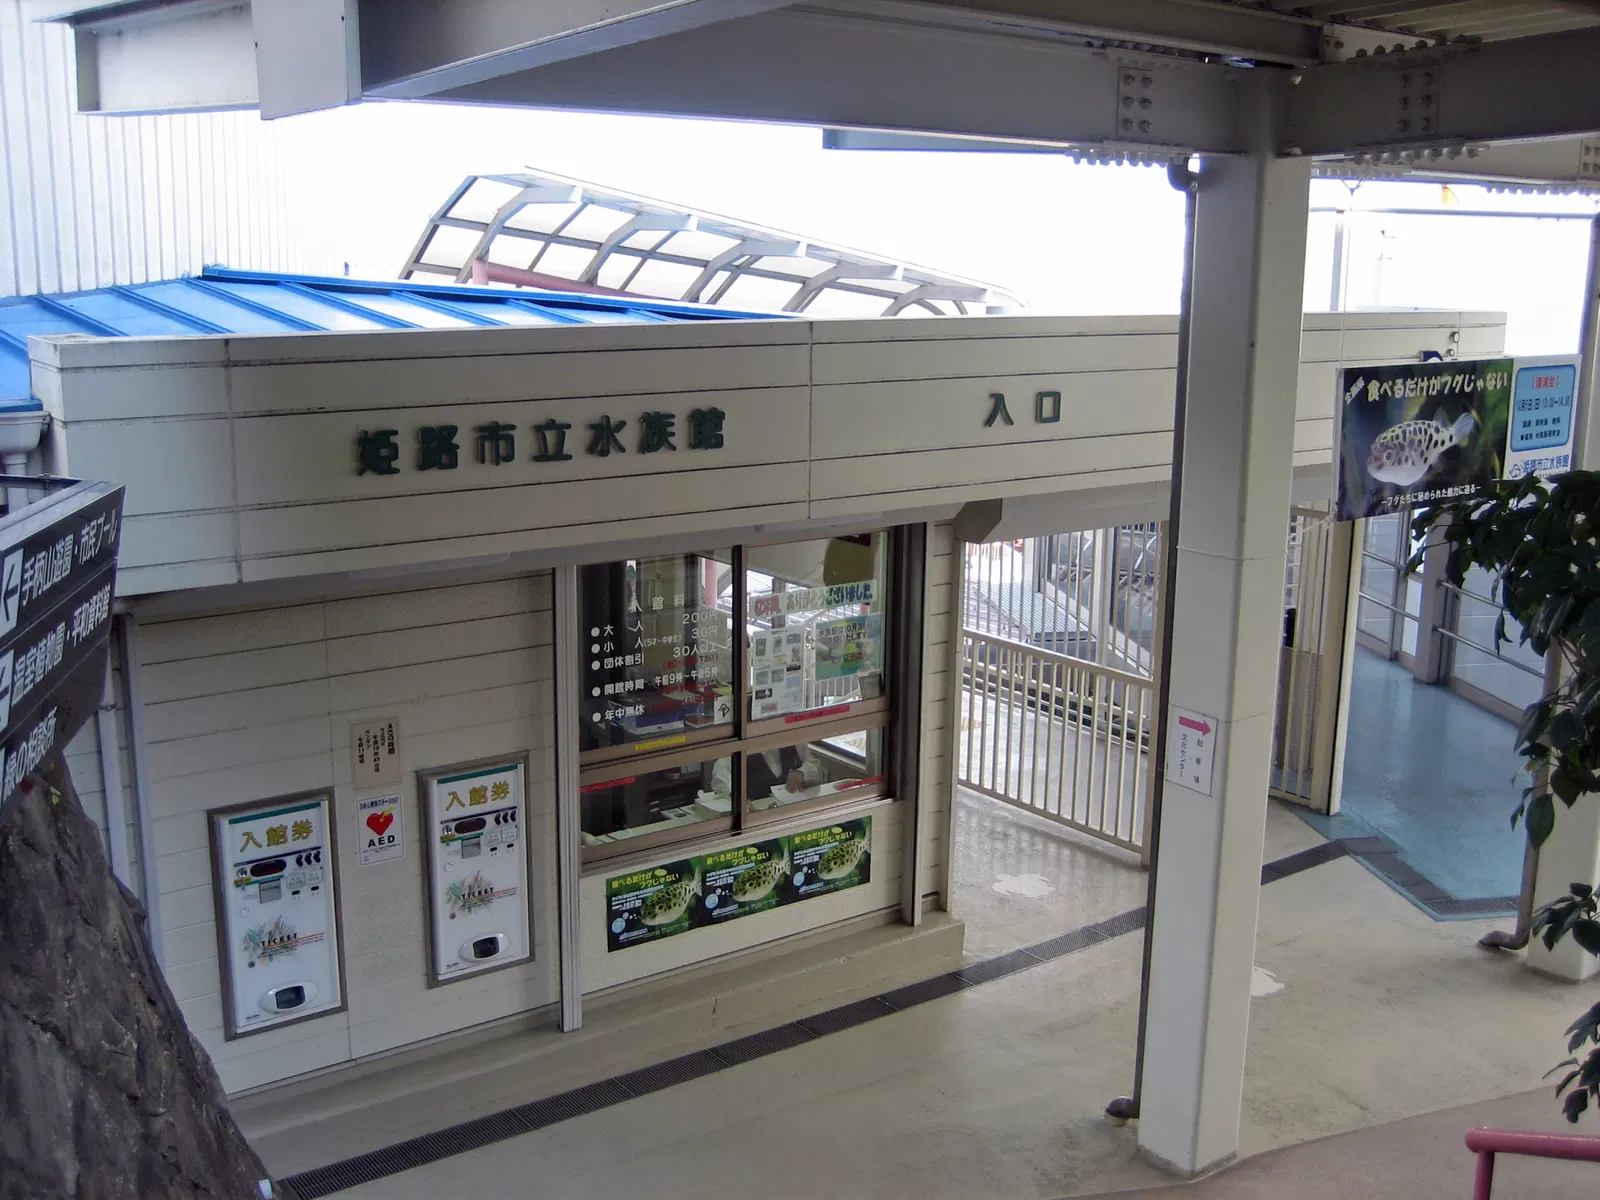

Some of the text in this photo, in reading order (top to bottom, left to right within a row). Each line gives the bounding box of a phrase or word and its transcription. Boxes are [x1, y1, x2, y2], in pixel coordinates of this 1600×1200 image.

[983, 391, 1062, 428] 入口
[355, 407, 726, 476] 姫路市立水族館
[21, 507, 118, 606] 手柄山遊園・市民プール
[604, 653, 645, 669] 団体割引
[604, 678, 645, 696] 開館時間
[604, 705, 645, 721] 年中無休
[445, 780, 511, 812] 入館券
[240, 818, 314, 853] 入館券
[367, 834, 396, 848] AED
[461, 887, 494, 900] TICKET
[261, 932, 298, 947] TICKET
